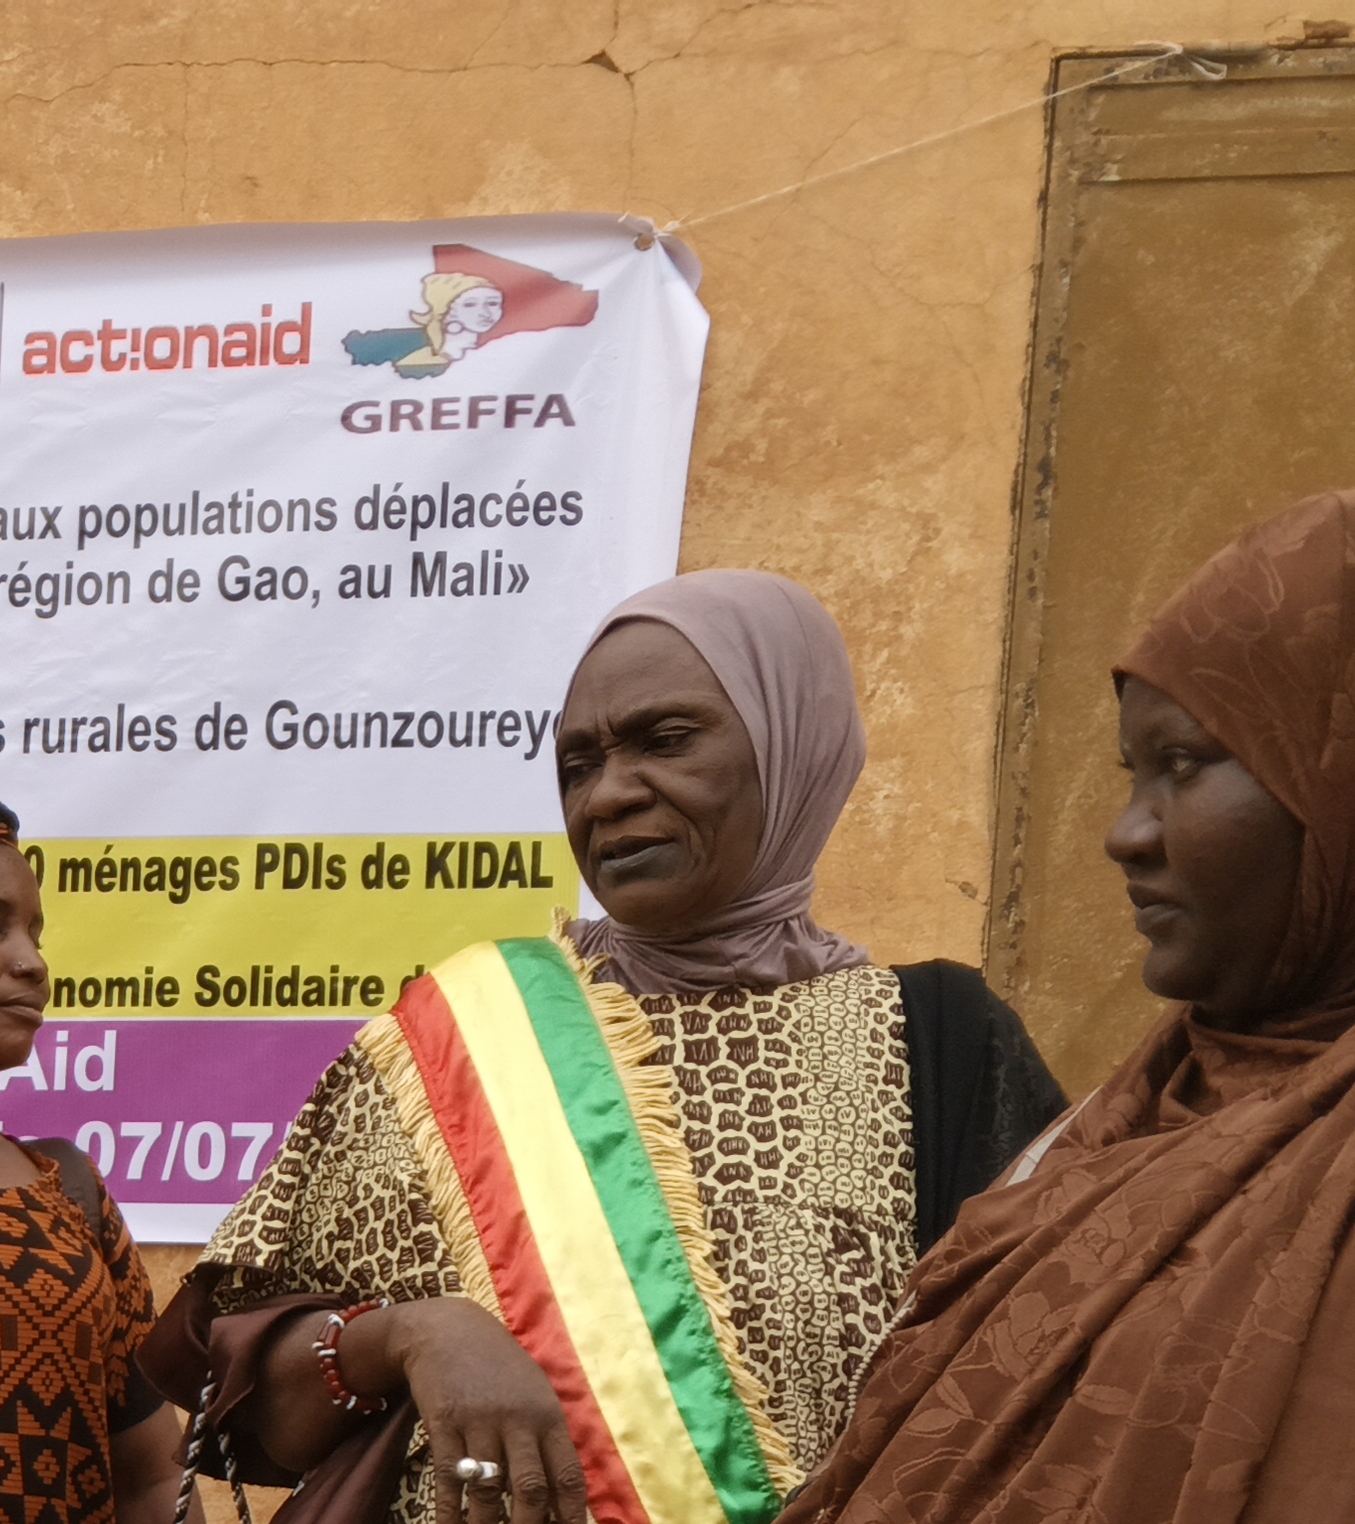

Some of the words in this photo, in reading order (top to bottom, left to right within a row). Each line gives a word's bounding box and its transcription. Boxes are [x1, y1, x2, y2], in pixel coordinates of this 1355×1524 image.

[340, 393, 576, 434] GREFFA
[78, 488, 338, 550] populations
[354, 479, 584, 541] déplacées
[147, 557, 201, 604] de
[217, 554, 322, 609] Gao,
[337, 563, 392, 600] au
[410, 549, 531, 598] Mali»
[22, 702, 179, 753] rurales
[194, 701, 249, 752] de
[56, 845, 240, 905] ménages
[253, 841, 348, 892] PDIs
[360, 844, 412, 891] de
[424, 840, 555, 892] KIDAL
[193, 964, 386, 1009] Solidaire
